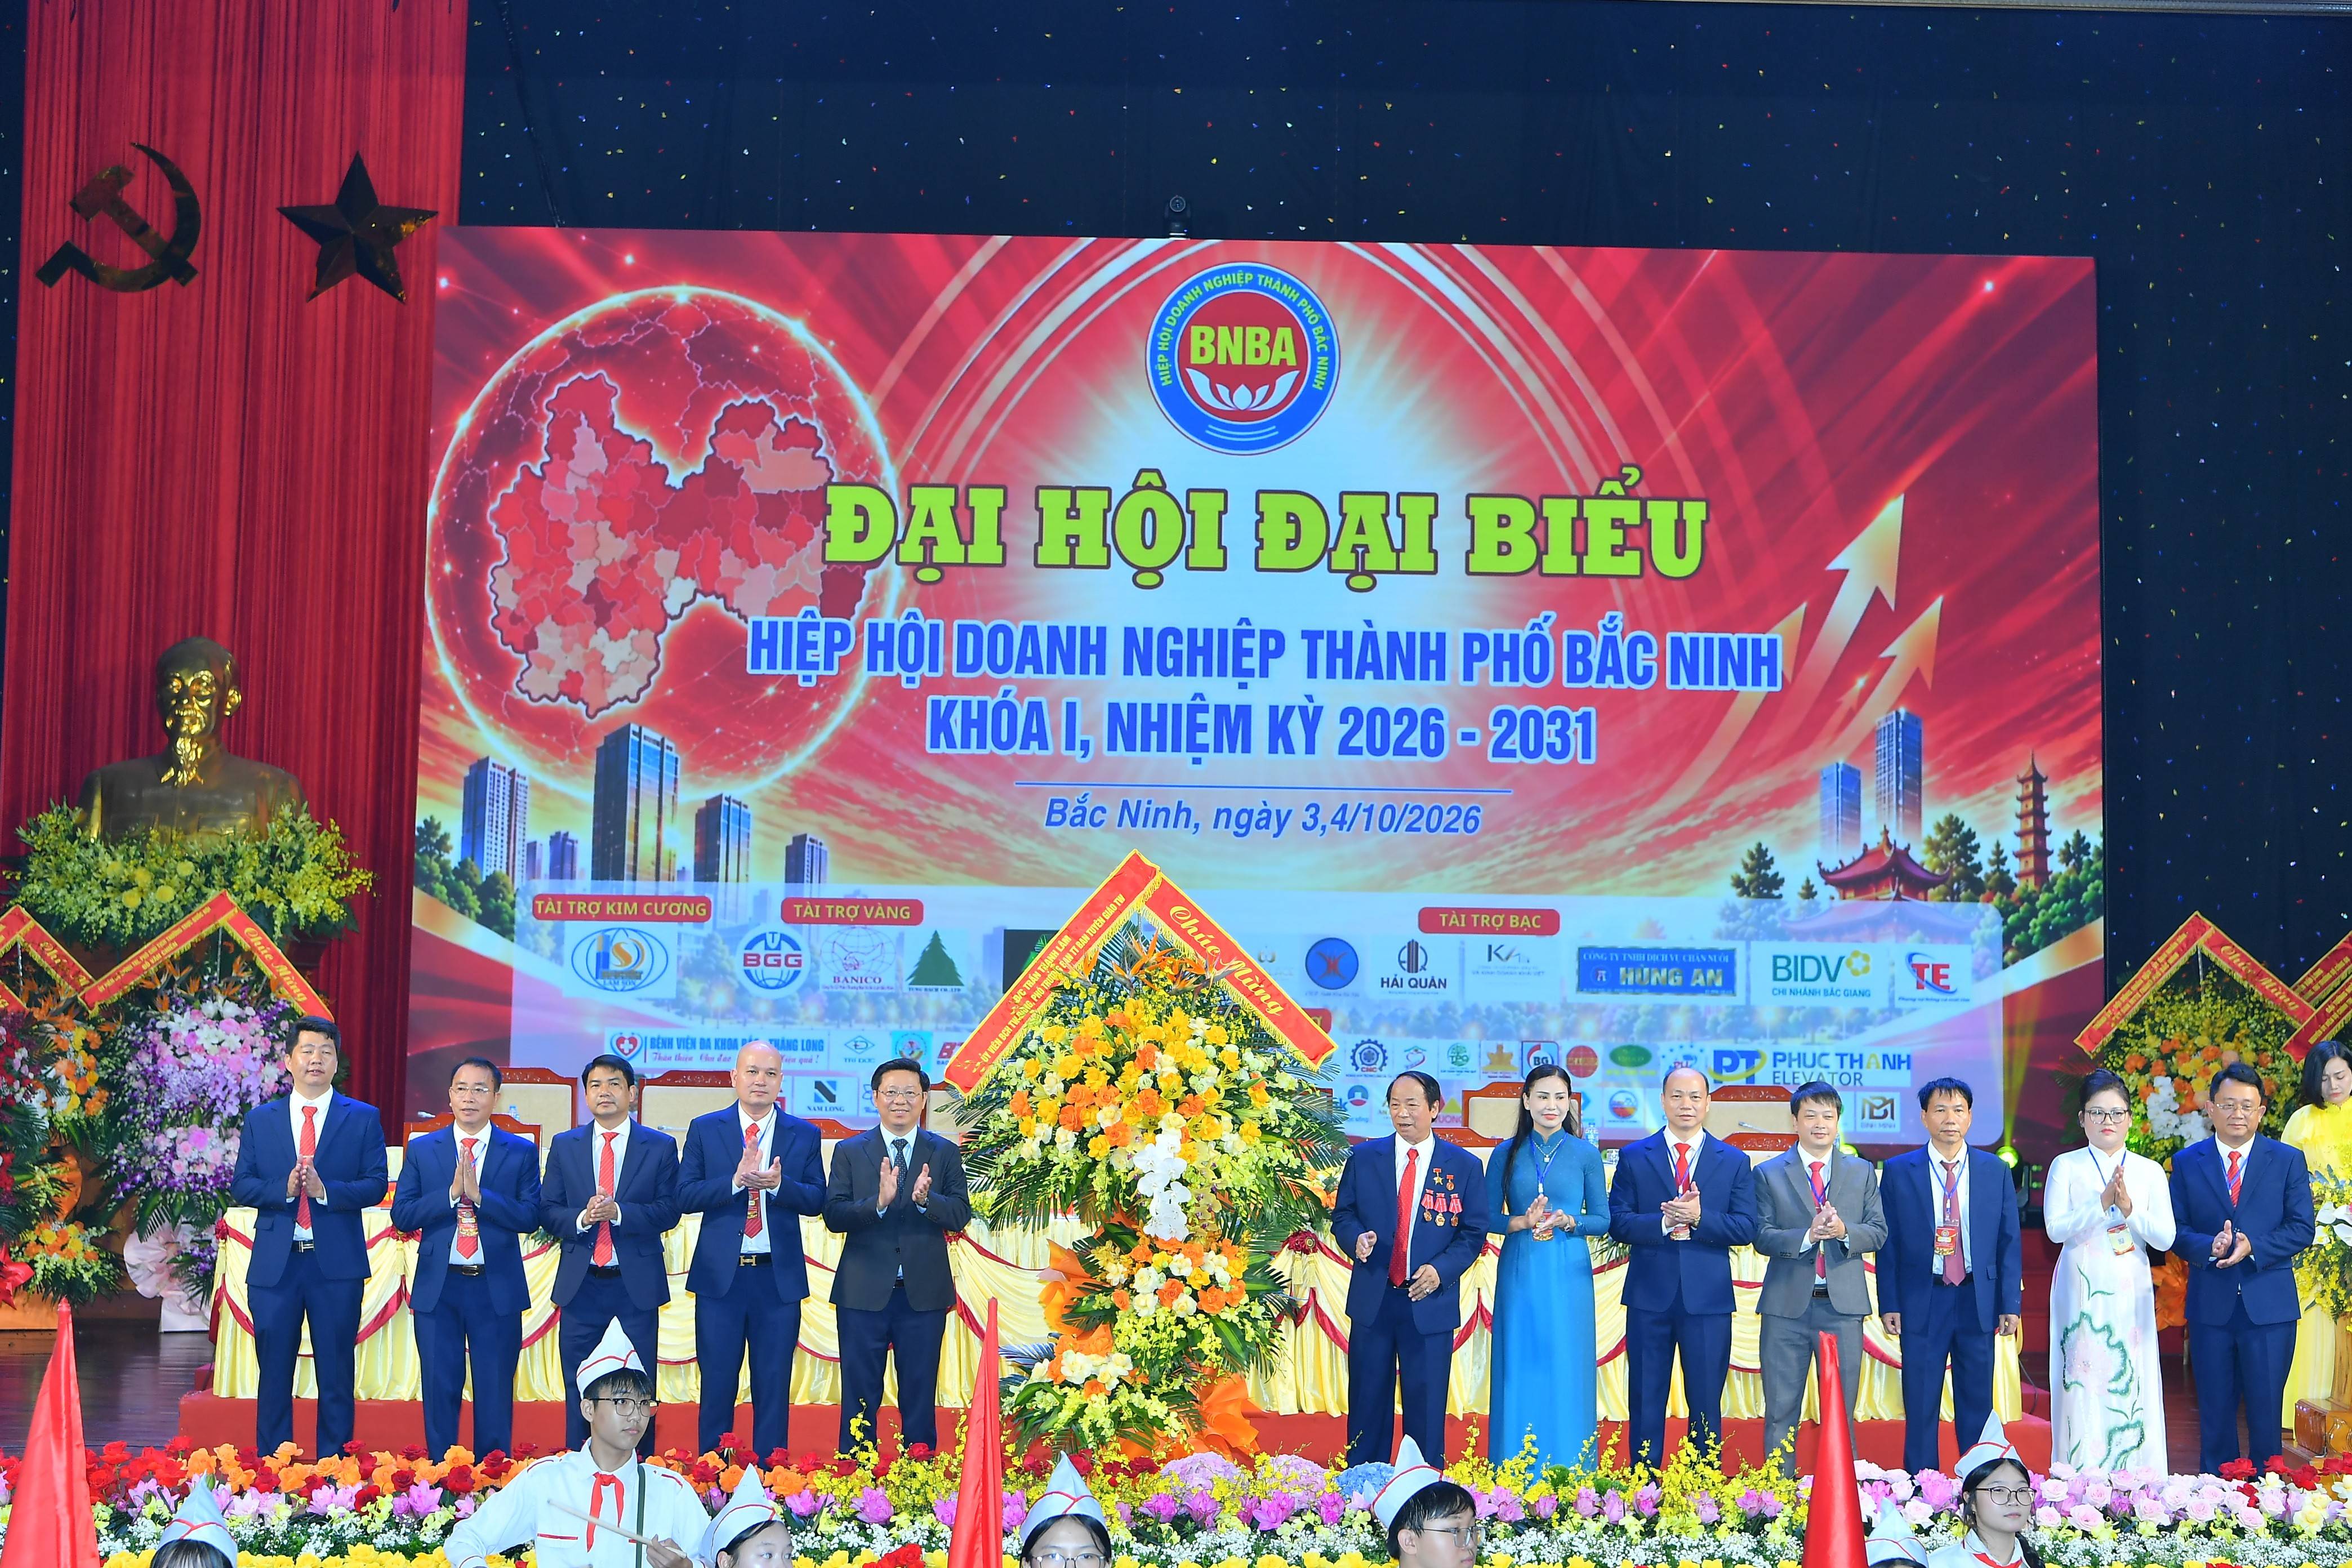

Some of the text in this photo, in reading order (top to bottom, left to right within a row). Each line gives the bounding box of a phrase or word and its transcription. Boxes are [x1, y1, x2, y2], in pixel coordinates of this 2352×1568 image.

[1203, 270, 1254, 291] NGHIỆP
[1257, 274, 1299, 302] THÀNH
[1165, 287, 1203, 327] DOANH
[1297, 298, 1322, 325] PHỐ
[1157, 327, 1174, 351] HỘI
[1190, 326, 1297, 366] BNBA
[1157, 354, 1173, 386] HIỆP
[1312, 357, 1329, 390] NINH
[823, 465, 1709, 592] ĐẠI HỘI ĐẠI BIỂU
[751, 611, 1778, 689] HIỆP HỘI DOANH NGHIỆP THÀNH PHỐ BẮC NINH
[932, 689, 1595, 765] KHÓA I, NHIỆM KỲ 2026 - 2031
[1045, 793, 1482, 838] Bắc Ninh, ngày 3,4/10/2026
[536, 897, 707, 917] TÀI TRỢ KIM CƯƠNG
[794, 902, 911, 921] TÀI TRỢ VÀNG
[1440, 911, 1540, 931] TÀI TRỢ BẠC
[243, 926, 274, 962] Chúc
[1054, 933, 1071, 952] LÂM
[743, 953, 802, 968] BGG
[1169, 905, 1285, 1017] Chúc Mừng
[1583, 951, 1607, 960] CÔNG
[833, 976, 882, 985] BANICO
[986, 1036, 1003, 1054] VIÊN
[997, 1025, 1013, 1040] BCH
[1029, 985, 1045, 1001] PHÓ
[1058, 952, 1073, 968] BAN
[1069, 945, 1080, 955] TT
[1076, 933, 1090, 948] BAN
[1084, 915, 1106, 937] TUYÊN
[1100, 902, 1117, 920] GIÁO
[1113, 893, 1126, 906] TW
[1381, 974, 1402, 988] HẢI
[1691, 968, 1723, 987] AN
[1772, 955, 1845, 983] BIDV
[1912, 963, 1950, 990] TE
[1789, 986, 1820, 996] NHÁNH
[1843, 989, 1871, 997] GIANG
[715, 1037, 738, 1050] KHOA
[802, 1039, 823, 1052] LONG
[1774, 1052, 1910, 1070] PHUC THANH
[1774, 1071, 1863, 1086] ELEVATOR
